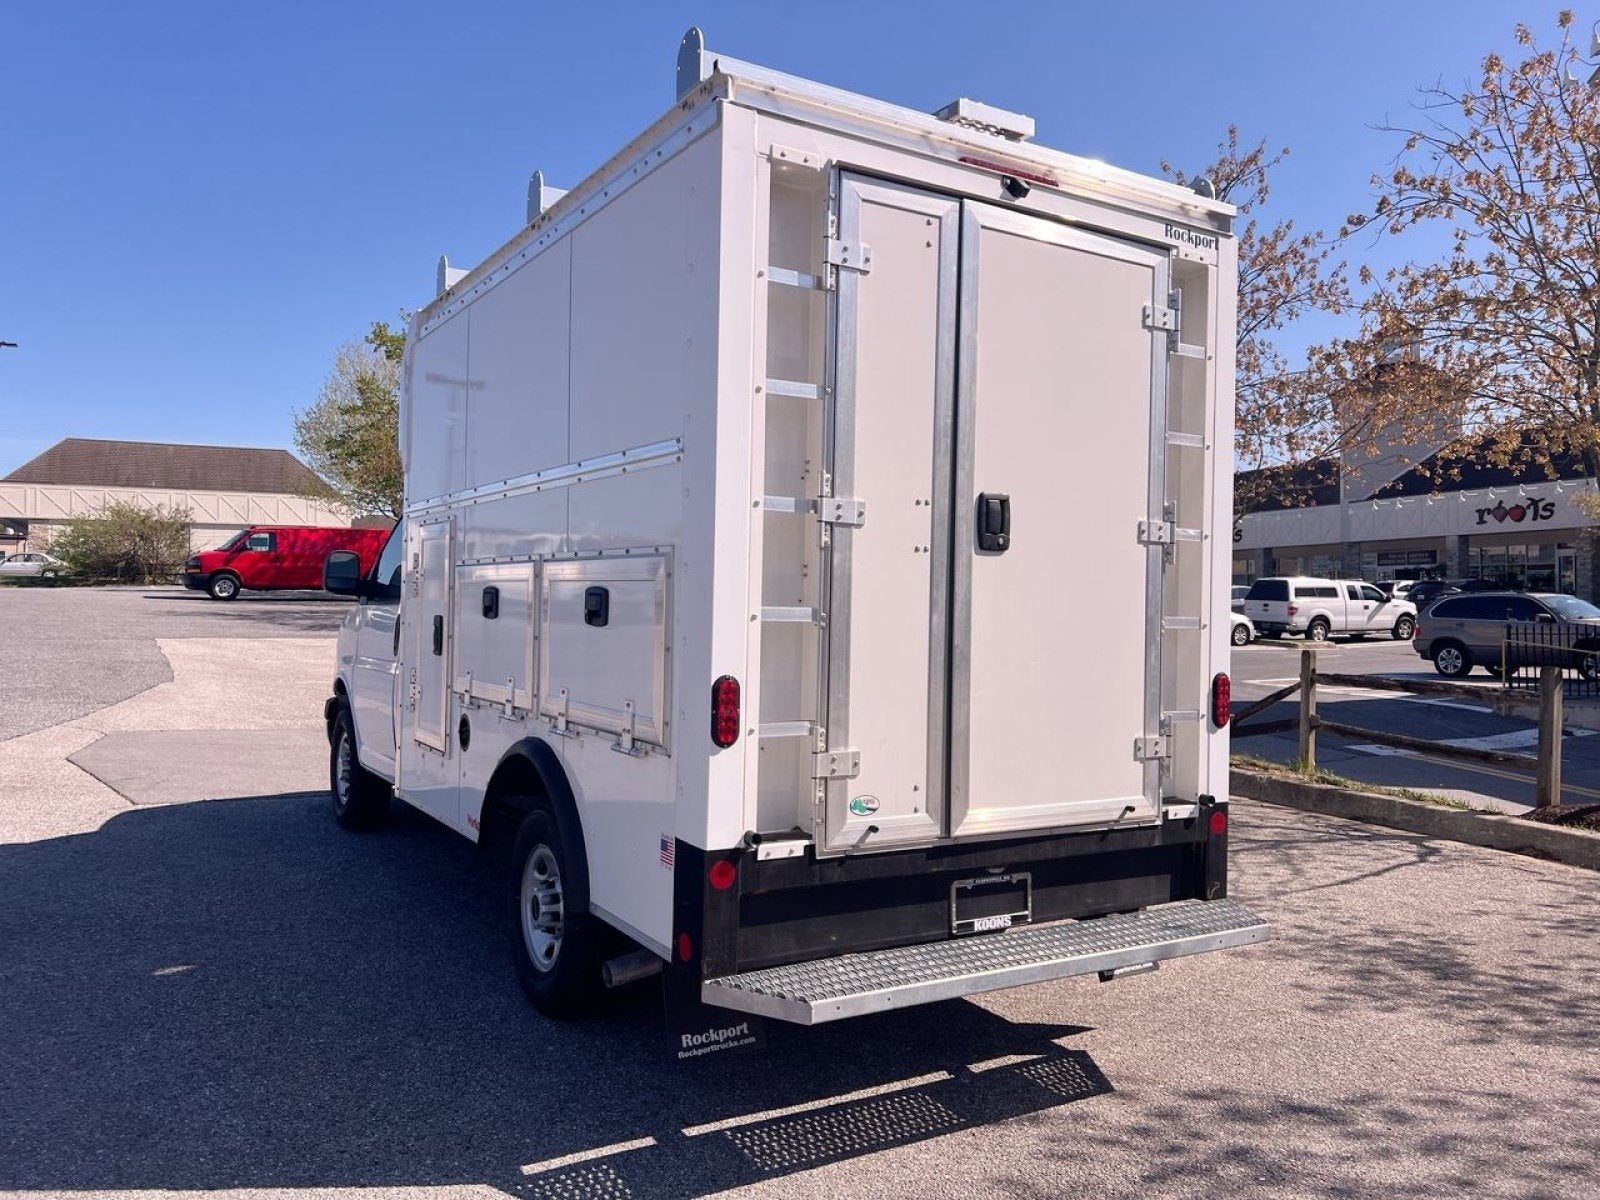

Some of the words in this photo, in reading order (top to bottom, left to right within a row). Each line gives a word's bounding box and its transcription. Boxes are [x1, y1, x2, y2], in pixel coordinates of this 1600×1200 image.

[974, 915, 1012, 932] KOONS
[681, 1022, 749, 1048] Rockport
[678, 1036, 756, 1060] Rockporttrucks.com
